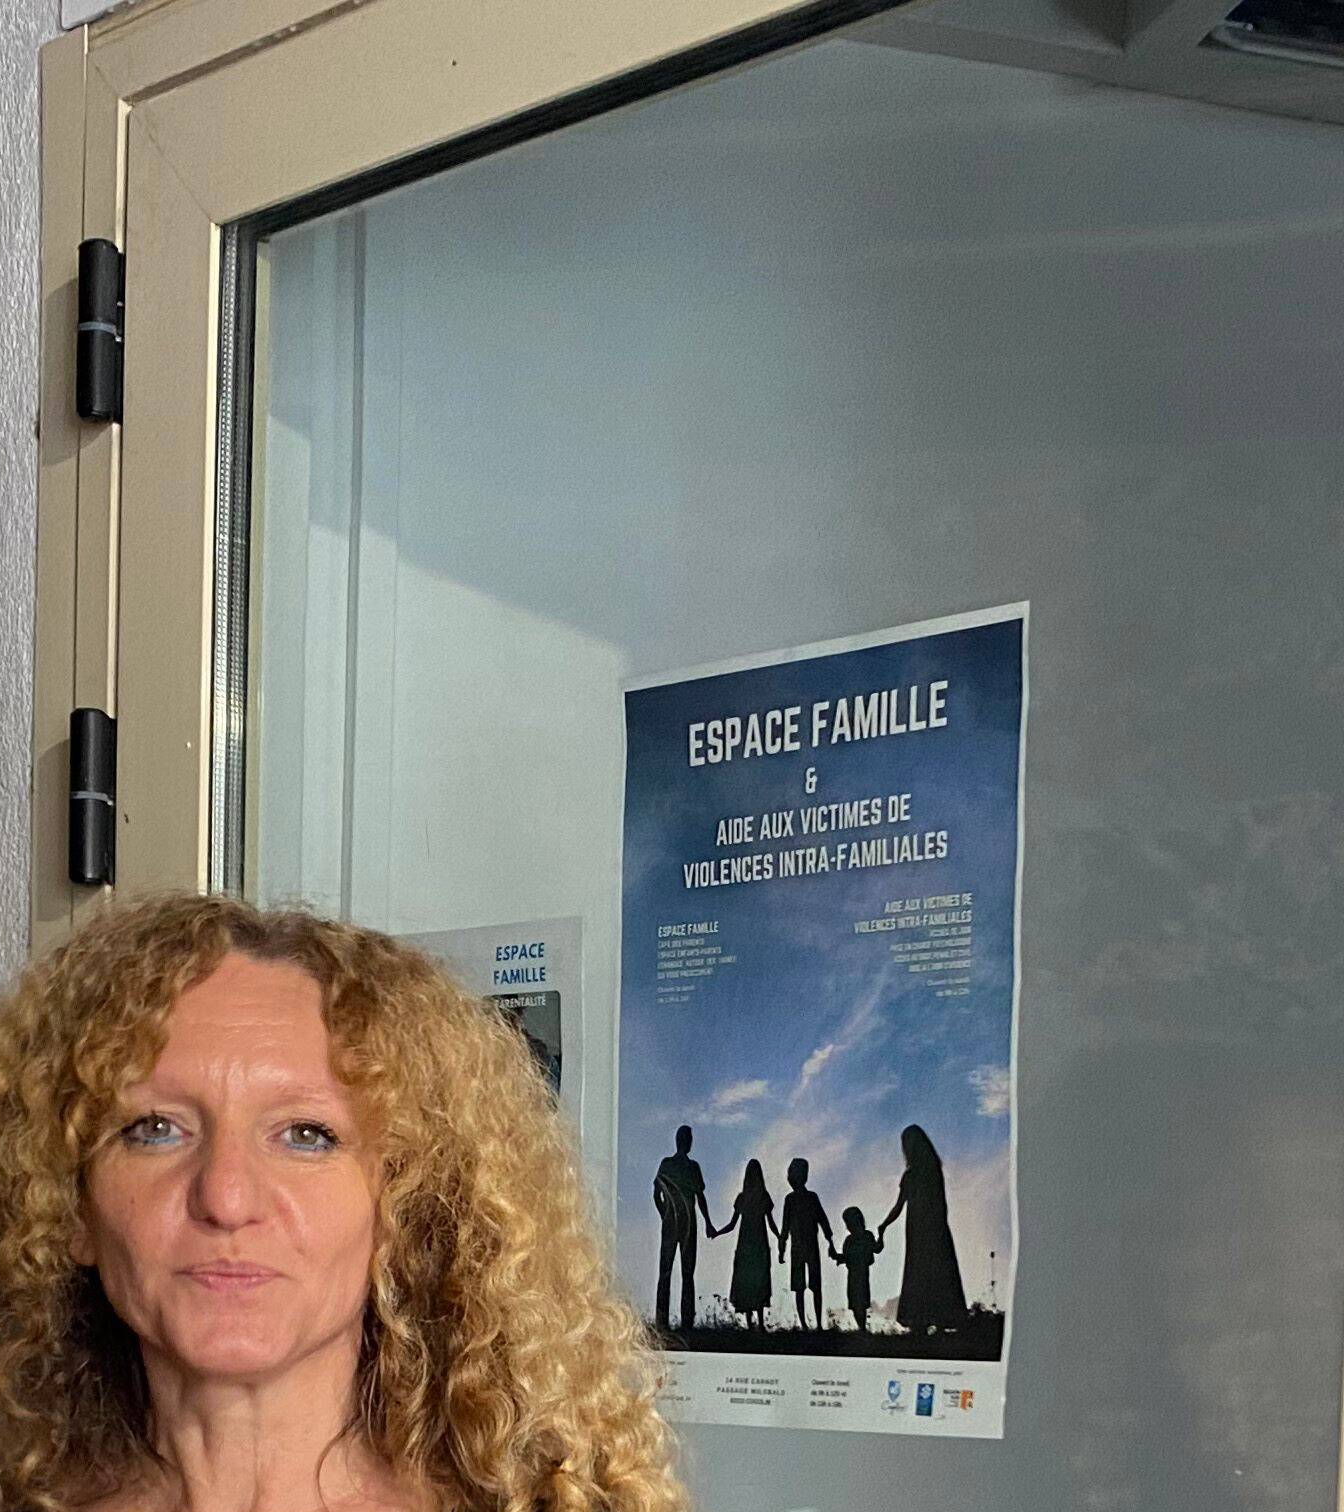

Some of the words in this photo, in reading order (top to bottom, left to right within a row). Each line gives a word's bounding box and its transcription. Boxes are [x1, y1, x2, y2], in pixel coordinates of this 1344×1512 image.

[688, 705, 801, 768] ESPACE
[811, 680, 949, 747] FAMILLE
[804, 767, 817, 793] &
[716, 815, 754, 846] AIDE
[759, 809, 793, 841] AUX
[801, 798, 882, 834] VICTIMES
[888, 793, 911, 822] DE
[683, 856, 774, 889] VIOLENCES
[779, 830, 948, 878] INTRA-FAMILIALES
[658, 923, 687, 938] ESPACE
[687, 921, 719, 936] FAMILLE
[496, 942, 545, 962] ESPACE
[493, 967, 547, 985] FAMILLE
